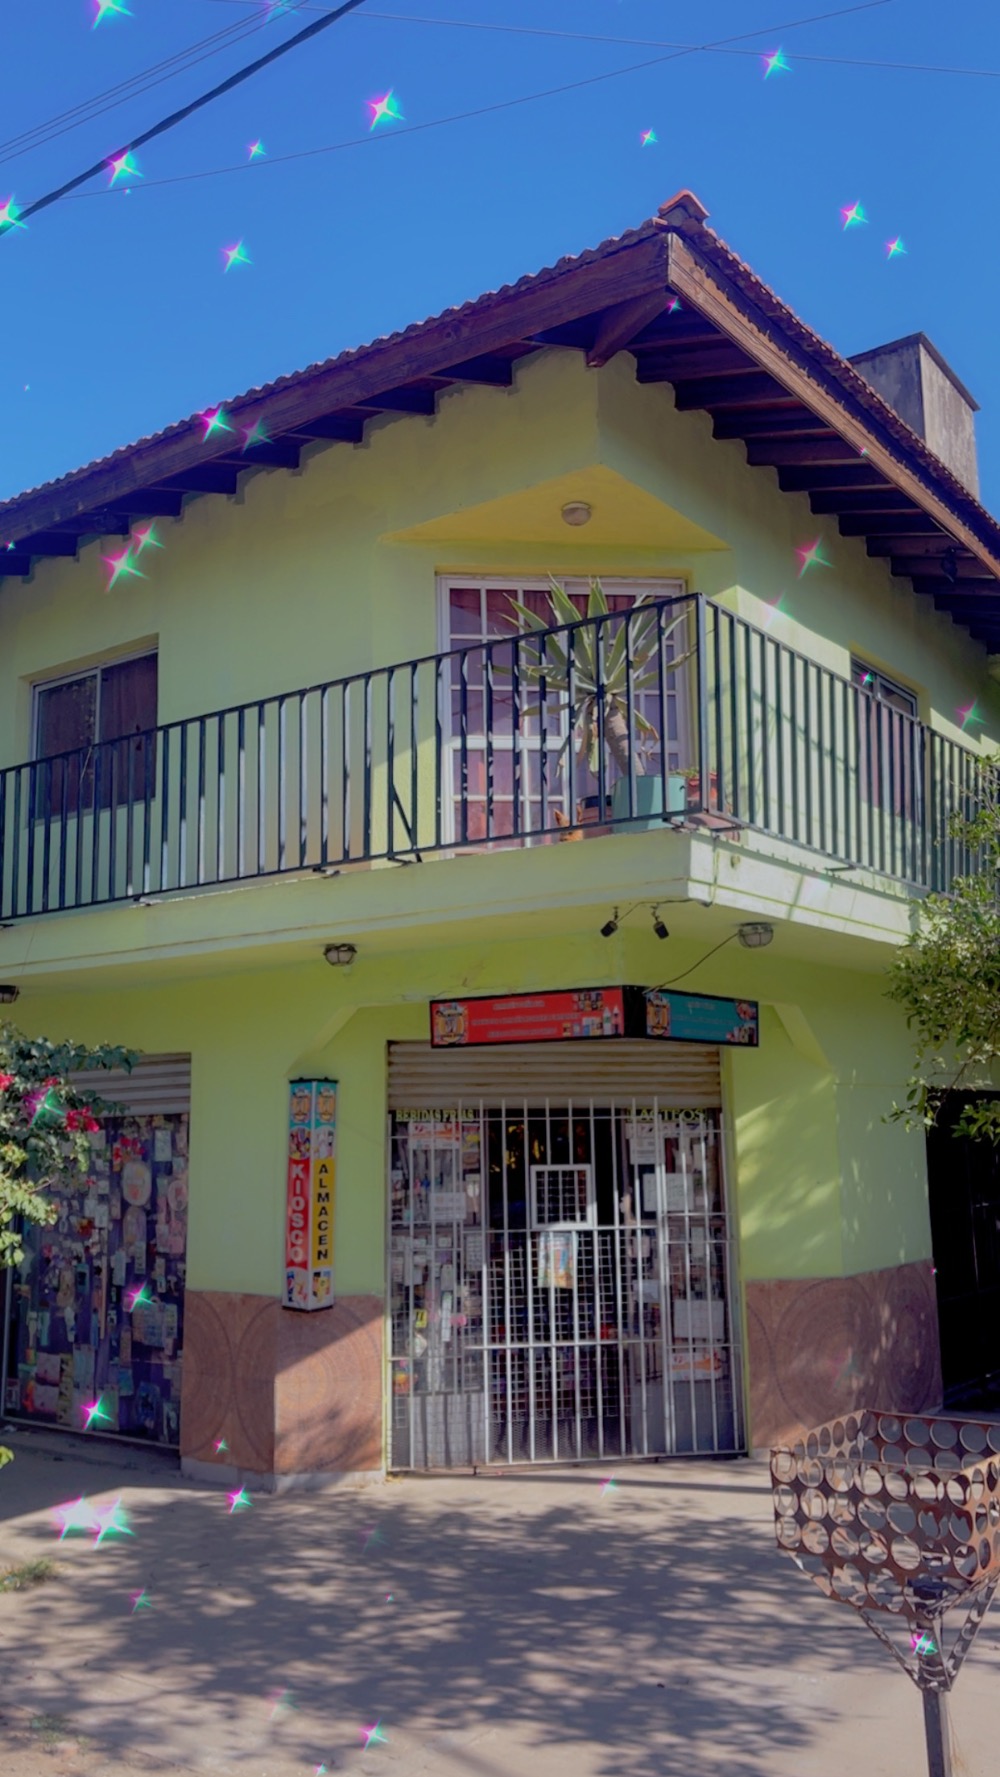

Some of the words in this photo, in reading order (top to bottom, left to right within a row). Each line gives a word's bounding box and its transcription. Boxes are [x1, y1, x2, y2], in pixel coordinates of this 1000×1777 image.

[396, 1109, 441, 1121] BEBIDAS
[443, 1109, 474, 1121] FRAS
[290, 1164, 305, 1263] KIOSCO
[317, 1164, 329, 1260] ALMACEN
